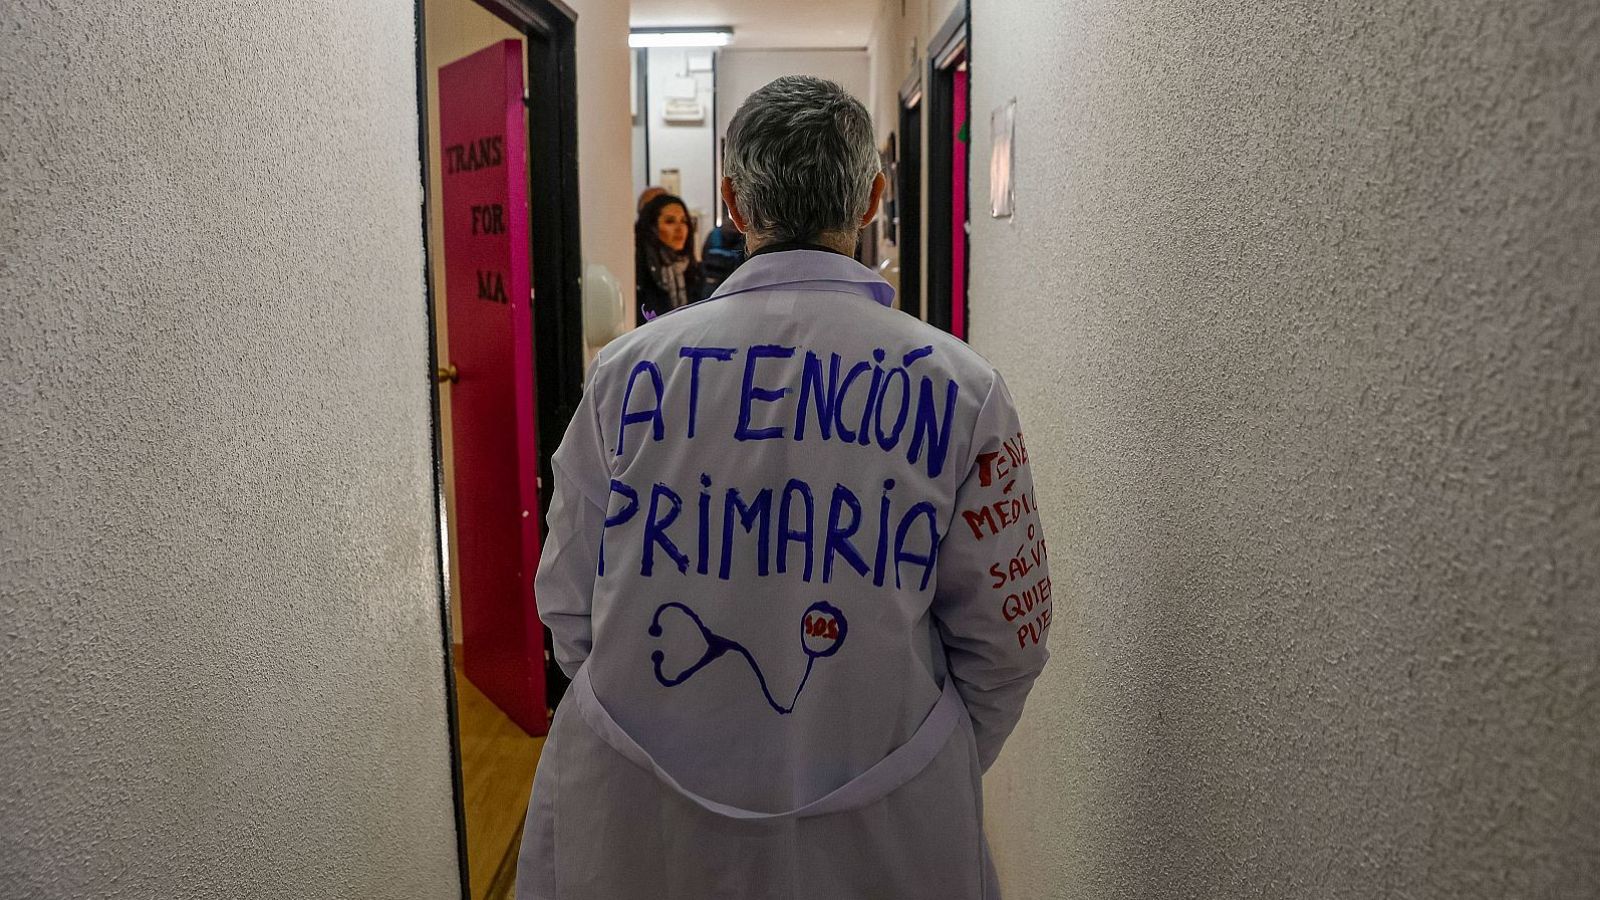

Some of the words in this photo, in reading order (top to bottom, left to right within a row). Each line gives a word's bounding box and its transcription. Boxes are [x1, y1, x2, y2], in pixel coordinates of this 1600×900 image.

[447, 135, 502, 174] TRANS
[471, 204, 506, 236] FOR
[476, 269, 508, 304] MA
[616, 344, 959, 478] ATENCIÓN
[598, 472, 941, 591] PRIMARIA
